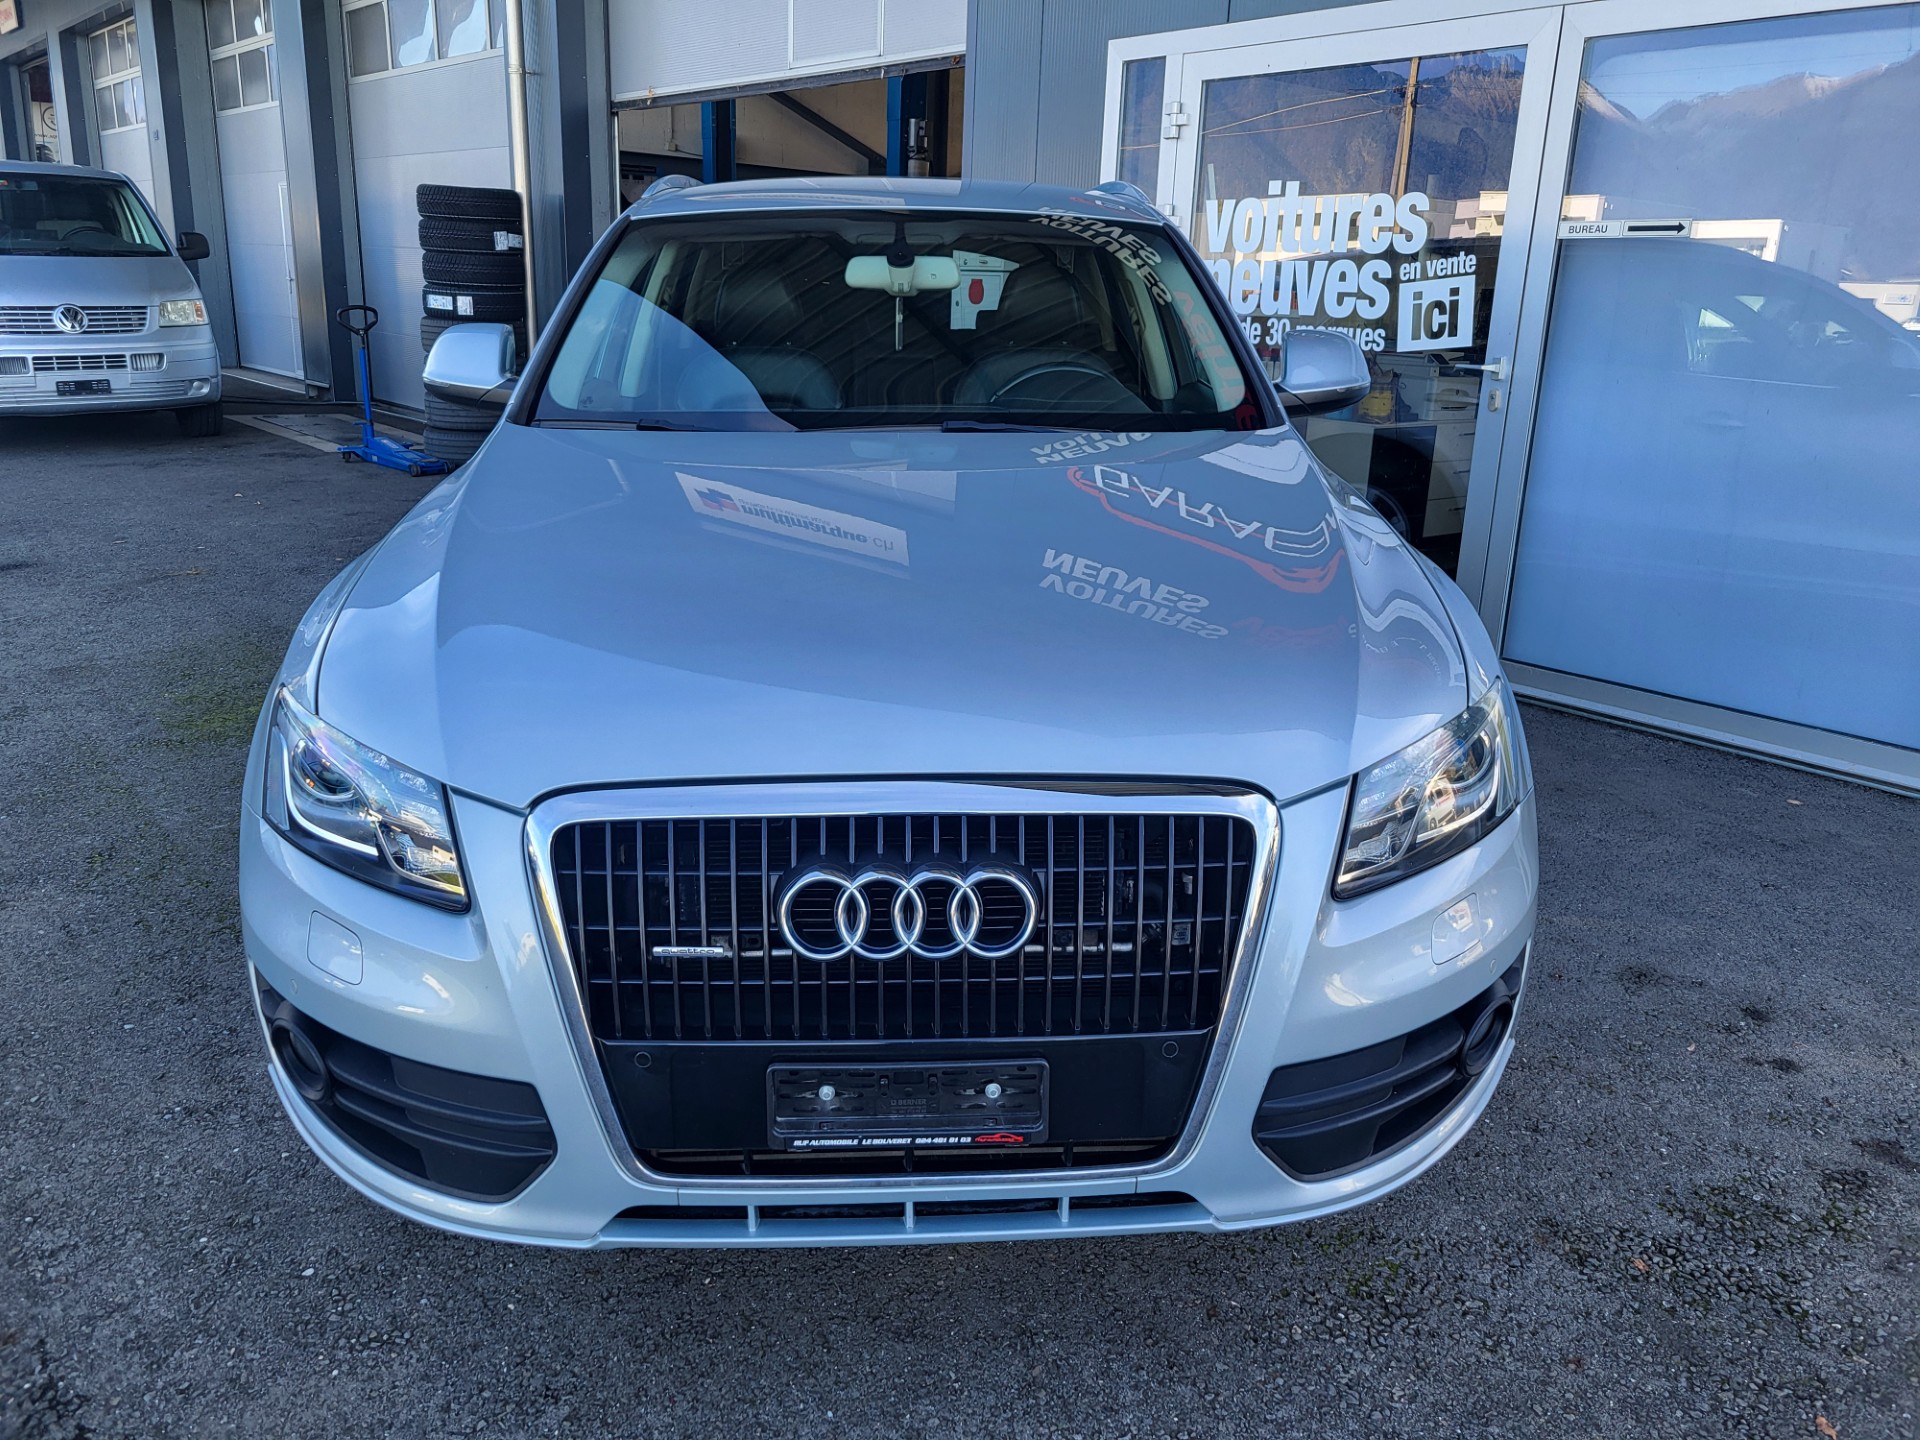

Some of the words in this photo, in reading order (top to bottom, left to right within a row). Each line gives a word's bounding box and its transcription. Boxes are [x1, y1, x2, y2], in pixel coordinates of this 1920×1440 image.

[1206, 180, 1430, 254] voitures
[1567, 223, 1609, 235] BUREAU
[1400, 262, 1423, 281] en
[1426, 251, 1477, 276] vente
[1204, 258, 1393, 320] neuves
[1411, 286, 1460, 341] ici
[1266, 317, 1290, 346] 30
[872, 1137, 912, 1145] BOUVERET
